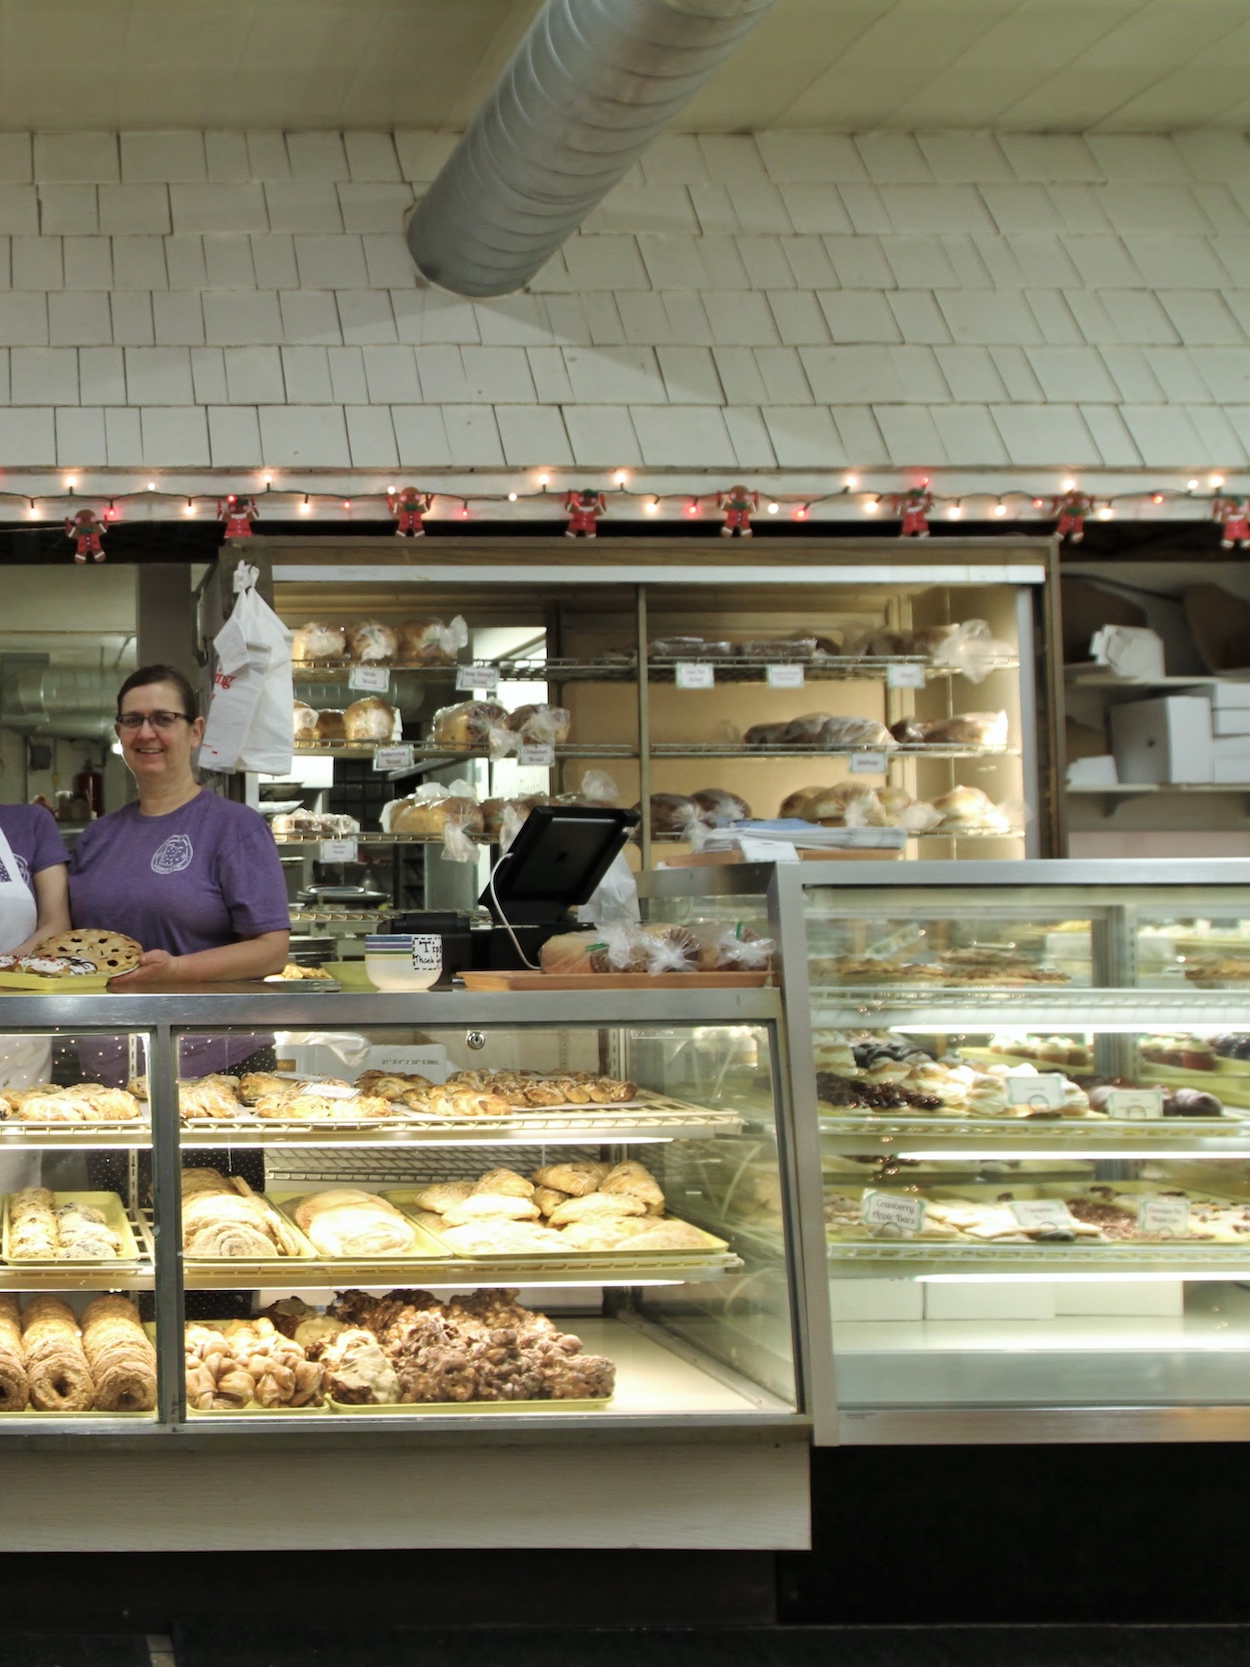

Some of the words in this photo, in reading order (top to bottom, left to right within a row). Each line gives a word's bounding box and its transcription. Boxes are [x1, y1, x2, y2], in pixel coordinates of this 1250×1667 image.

[876, 1198, 915, 1215] Cranberry
[871, 1210, 894, 1221] Apple
[895, 1214, 916, 1225] Bars
